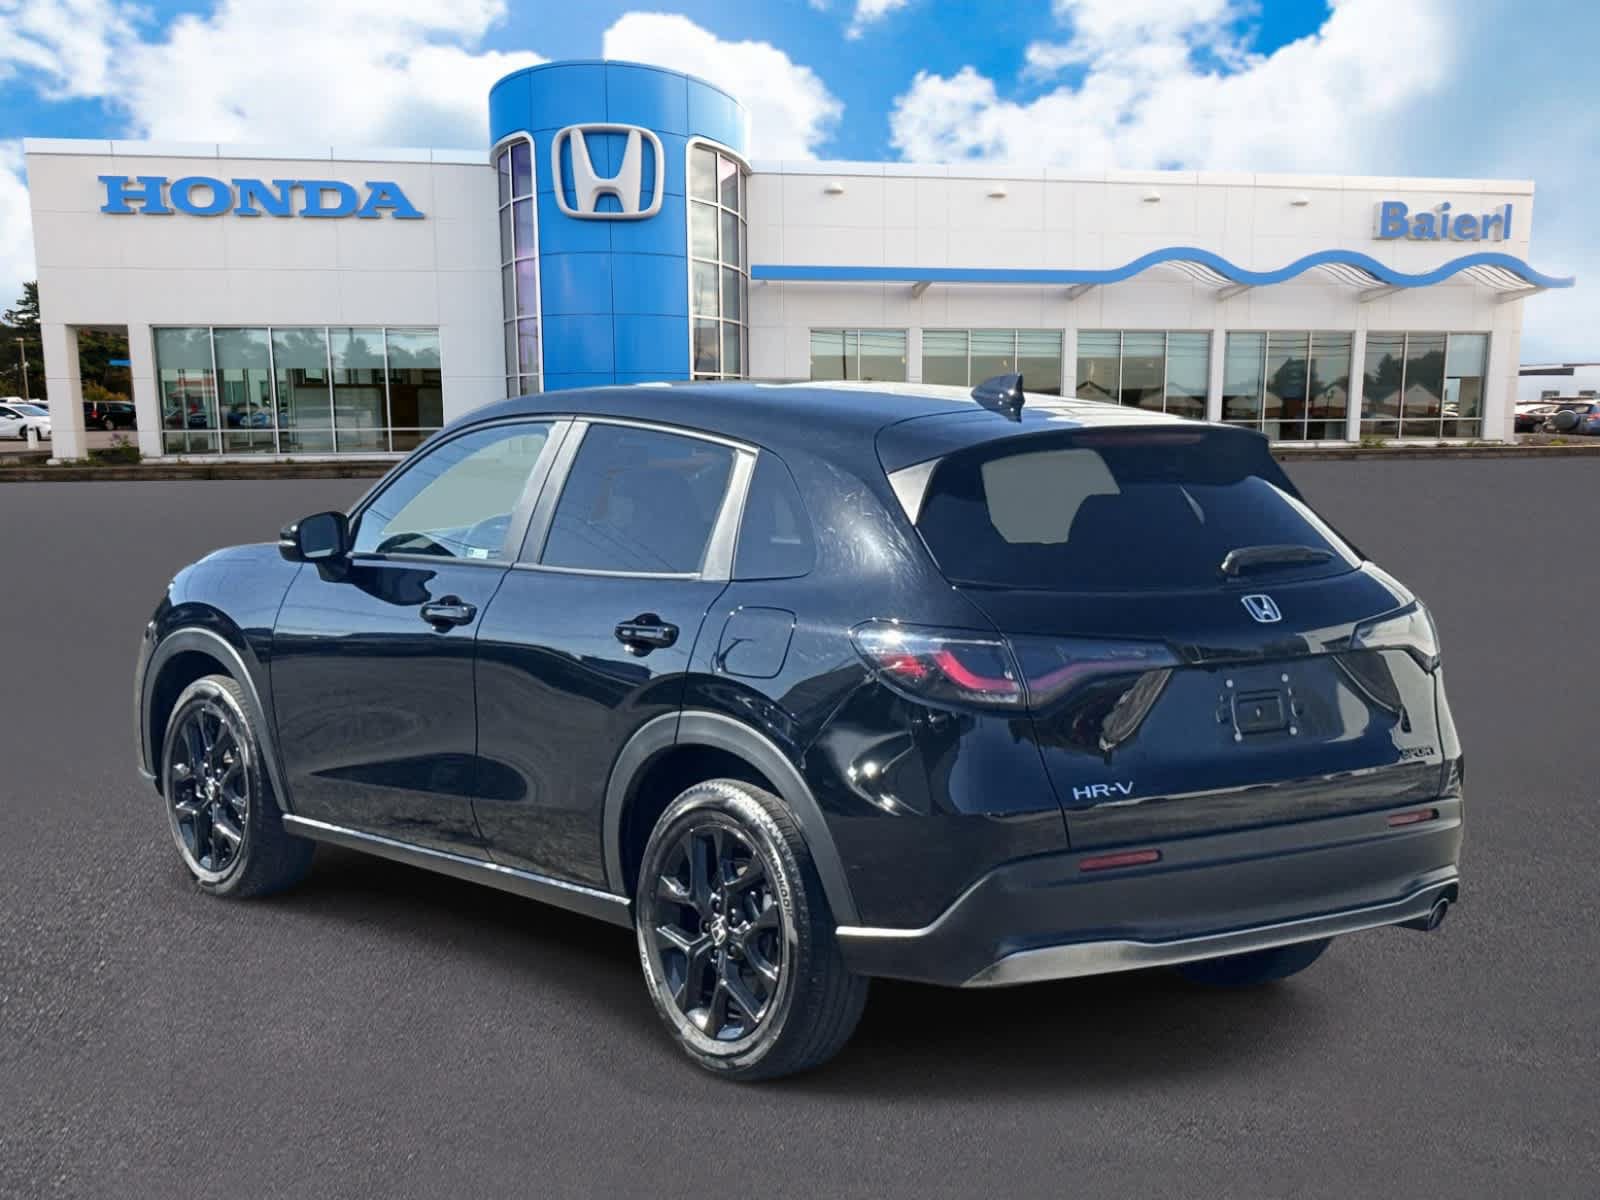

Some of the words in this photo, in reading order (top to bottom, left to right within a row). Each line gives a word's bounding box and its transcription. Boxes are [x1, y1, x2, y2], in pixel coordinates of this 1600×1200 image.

[97, 175, 425, 219] HONDA
[1380, 201, 1513, 240] Baierl
[1072, 780, 1134, 801] HR-V
